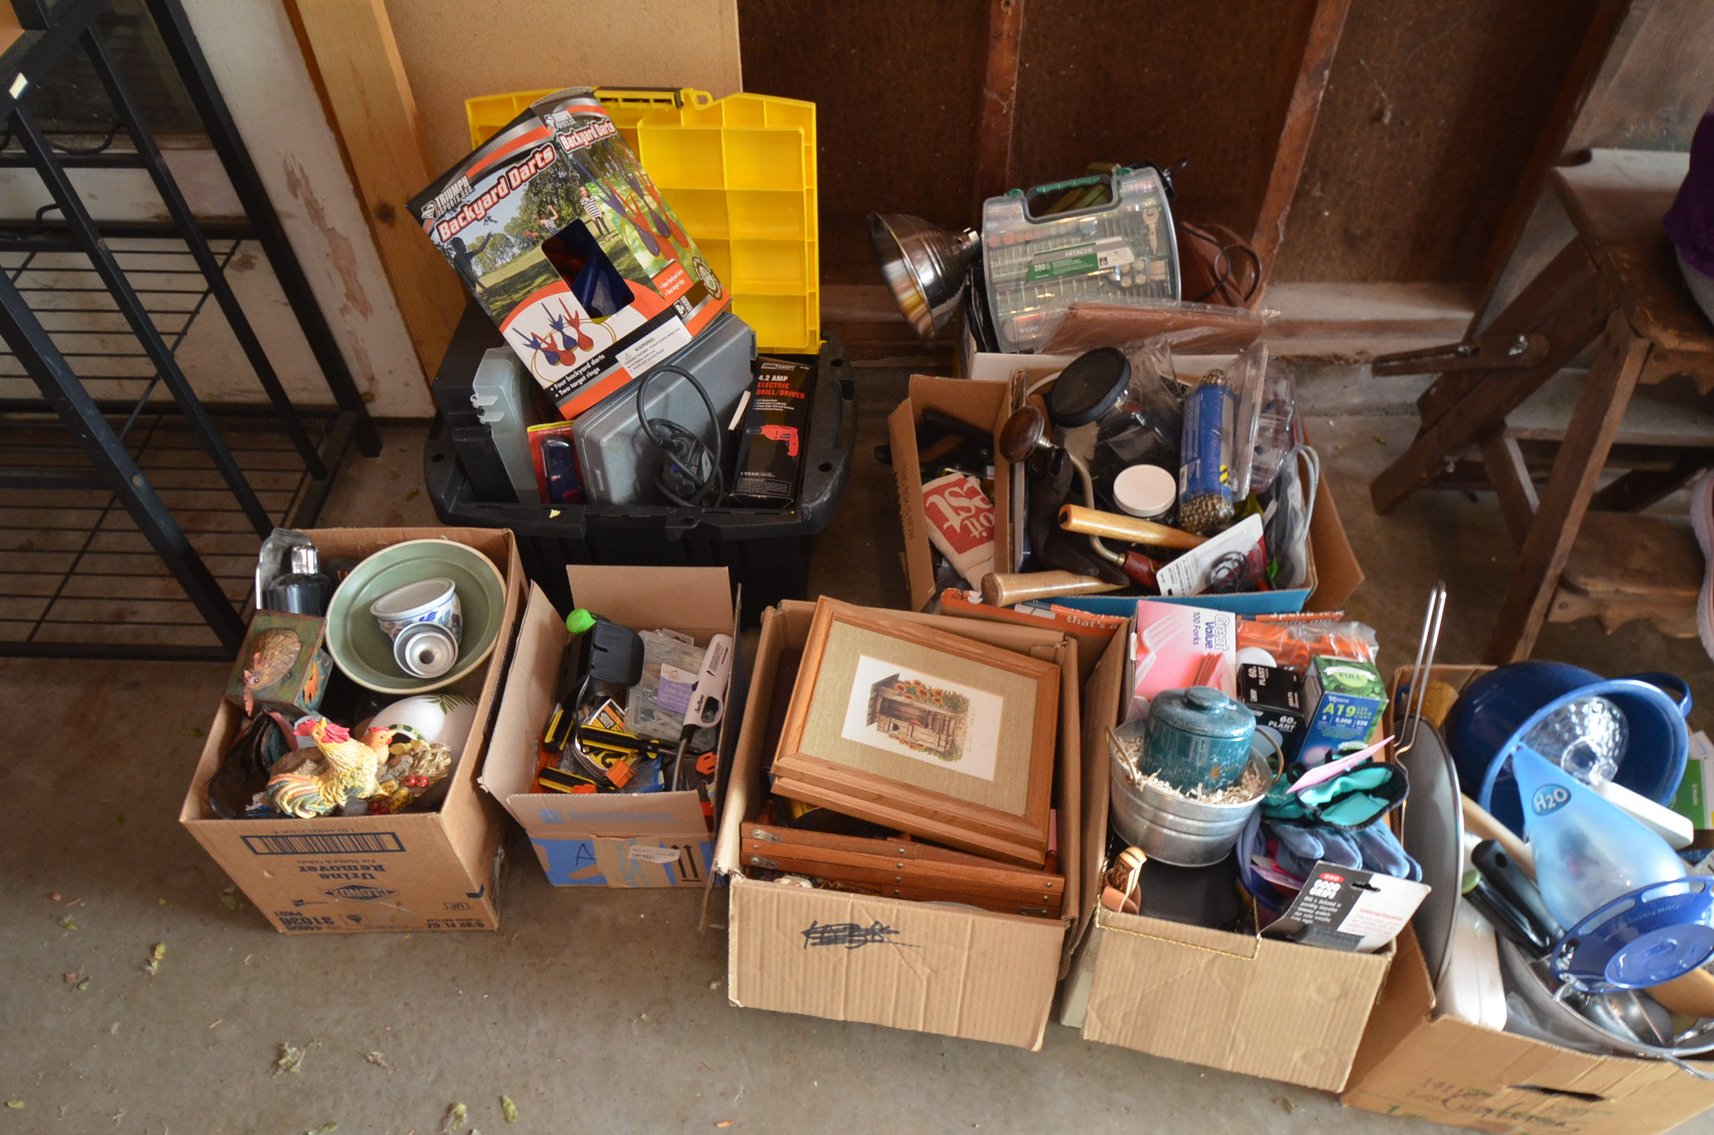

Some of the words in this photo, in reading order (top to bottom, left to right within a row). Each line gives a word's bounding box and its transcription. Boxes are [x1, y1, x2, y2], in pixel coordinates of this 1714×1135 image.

[558, 123, 598, 152] Backyard
[596, 118, 617, 140] Darts
[435, 173, 470, 207] TRIUMPH
[437, 175, 511, 243] Backyard
[506, 143, 556, 190] Darts
[1064, 247, 1093, 258] HITACHI
[553, 379, 566, 391] Four
[565, 362, 591, 382] backyard
[591, 354, 606, 366] darts
[559, 386, 571, 396] Two
[570, 375, 587, 392] target
[586, 366, 601, 380] rings
[771, 374, 788, 382] AMP
[1066, 614, 1106, 629] that's
[1193, 611, 1201, 624] 100
[1192, 625, 1201, 645] Forks
[1205, 621, 1215, 649] Value
[1214, 614, 1230, 651] Great
[1258, 667, 1266, 686] PLANT
[1322, 702, 1357, 717] A19
[1268, 720, 1296, 730] PLANT
[1533, 786, 1569, 811] H2O
[297, 864, 386, 873] Remover
[319, 872, 376, 881] Urine
[1313, 880, 1341, 892] GOOD
